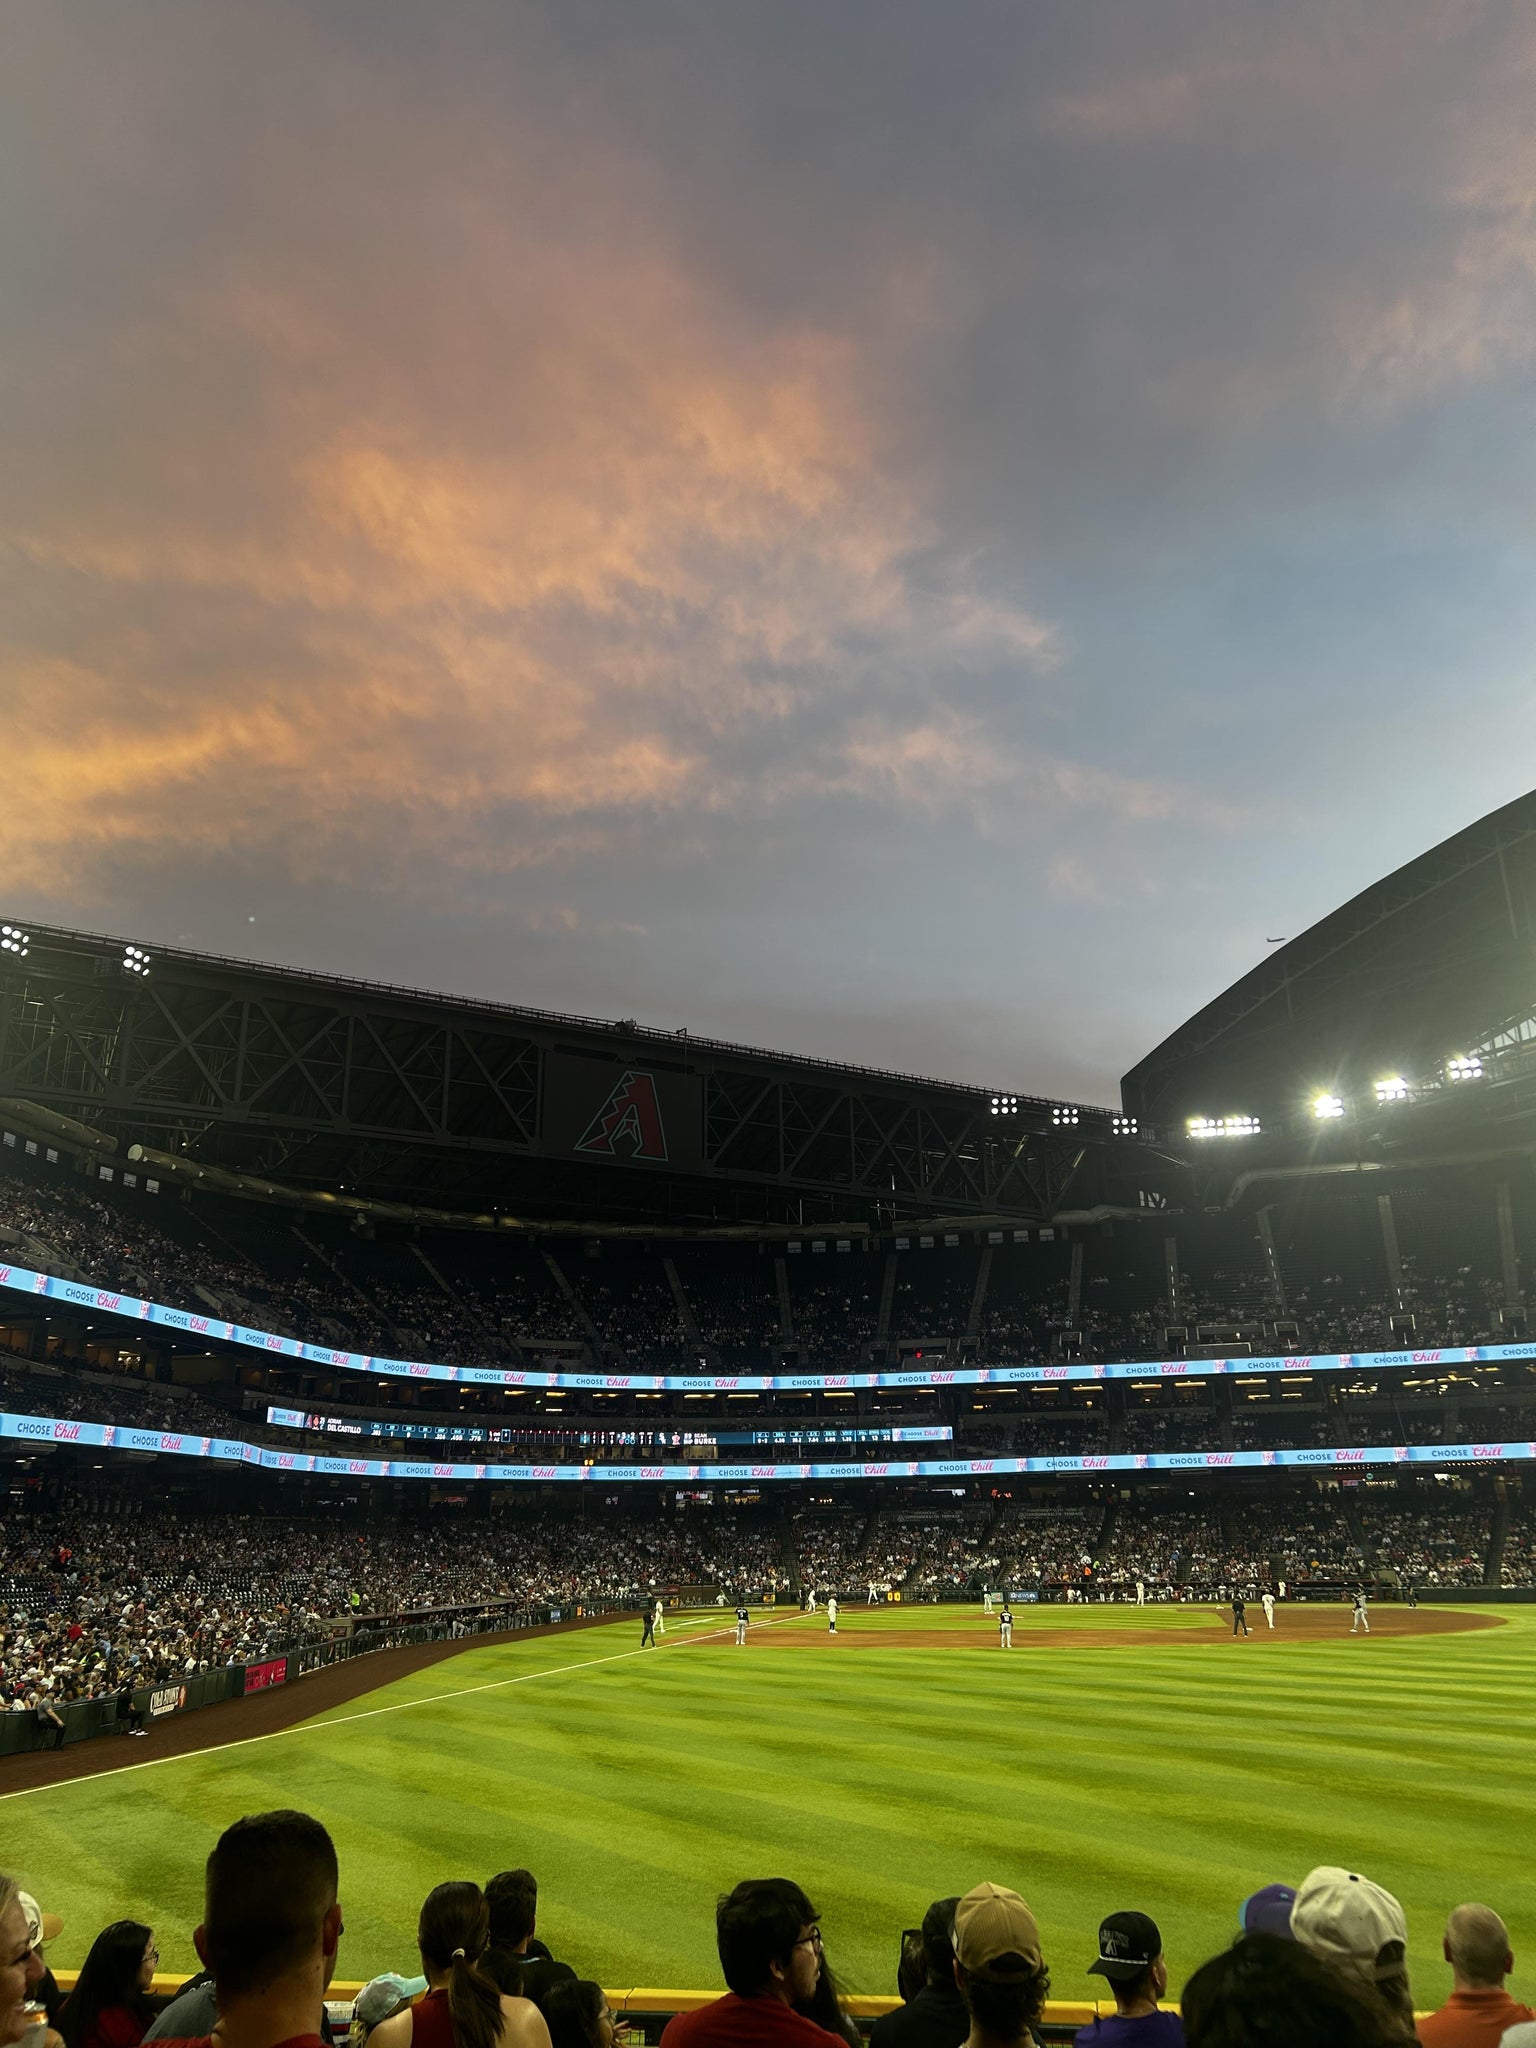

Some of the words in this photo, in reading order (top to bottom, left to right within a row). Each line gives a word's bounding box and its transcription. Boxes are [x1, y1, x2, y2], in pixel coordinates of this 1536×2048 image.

[65, 1287, 94, 1303] CHOOSE
[97, 1293, 120, 1310] Chill
[164, 1313, 188, 1326] CHOOSE
[191, 1317, 208, 1332] Chill
[245, 1333, 264, 1344] CHOOSE
[267, 1337, 282, 1349] Chill
[313, 1350, 330, 1362] CHOOSE
[333, 1353, 349, 1365] Chill
[1373, 1355, 1408, 1364] CHOOSE
[1412, 1352, 1441, 1362] Chill
[1126, 1366, 1157, 1374] CHOOSE
[1161, 1364, 1186, 1374] Chill
[1247, 1361, 1280, 1369] CHOOSE
[1284, 1358, 1311, 1368] Chill
[384, 1363, 407, 1373] CHOOSE
[410, 1364, 429, 1376] Chill
[1009, 1371, 1039, 1379] CHOOSE
[1043, 1368, 1067, 1378] Chill
[474, 1372, 501, 1382] CHOOSE
[504, 1373, 525, 1383] Chill
[576, 1377, 603, 1386] CHOOSE
[607, 1377, 629, 1387] Chill
[682, 1379, 711, 1388] CHOOSE
[715, 1378, 738, 1388] Chill
[791, 1378, 820, 1386] CHOOSE
[824, 1376, 847, 1386] Chill
[897, 1374, 926, 1383] CHOOSE
[930, 1373, 954, 1383] Chill
[17, 1422, 50, 1436] CHOOSE
[54, 1423, 80, 1439] Chill
[327, 1424, 337, 1432] DEL
[337, 1425, 361, 1434] CASTILLO
[131, 1435, 158, 1446] CHOOSE
[161, 1437, 181, 1450] Chill
[1297, 1453, 1331, 1461] CHOOSE
[1335, 1450, 1364, 1461] Chill
[1431, 1449, 1467, 1457] CHOOSE
[1472, 1446, 1503, 1457] Chill
[279, 1455, 295, 1467] Chill
[1046, 1460, 1078, 1468] CHOOSE
[1082, 1457, 1108, 1468] Chill
[1169, 1456, 1202, 1464] CHOOSE
[1206, 1454, 1233, 1465] Chill
[325, 1461, 347, 1471] CHOOSE
[350, 1462, 367, 1473] Chill
[406, 1466, 430, 1474] CHOOSE
[434, 1466, 453, 1476] Chill
[752, 1467, 775, 1477] Chill
[830, 1467, 860, 1475] CHOOSE
[864, 1465, 887, 1475] Chill
[938, 1464, 968, 1472] CHOOSE
[971, 1461, 993, 1471] Chill
[502, 1468, 529, 1477] CHOOSE
[532, 1467, 555, 1478] Chill
[607, 1469, 636, 1477] CHOOSE
[640, 1468, 664, 1478] Chill
